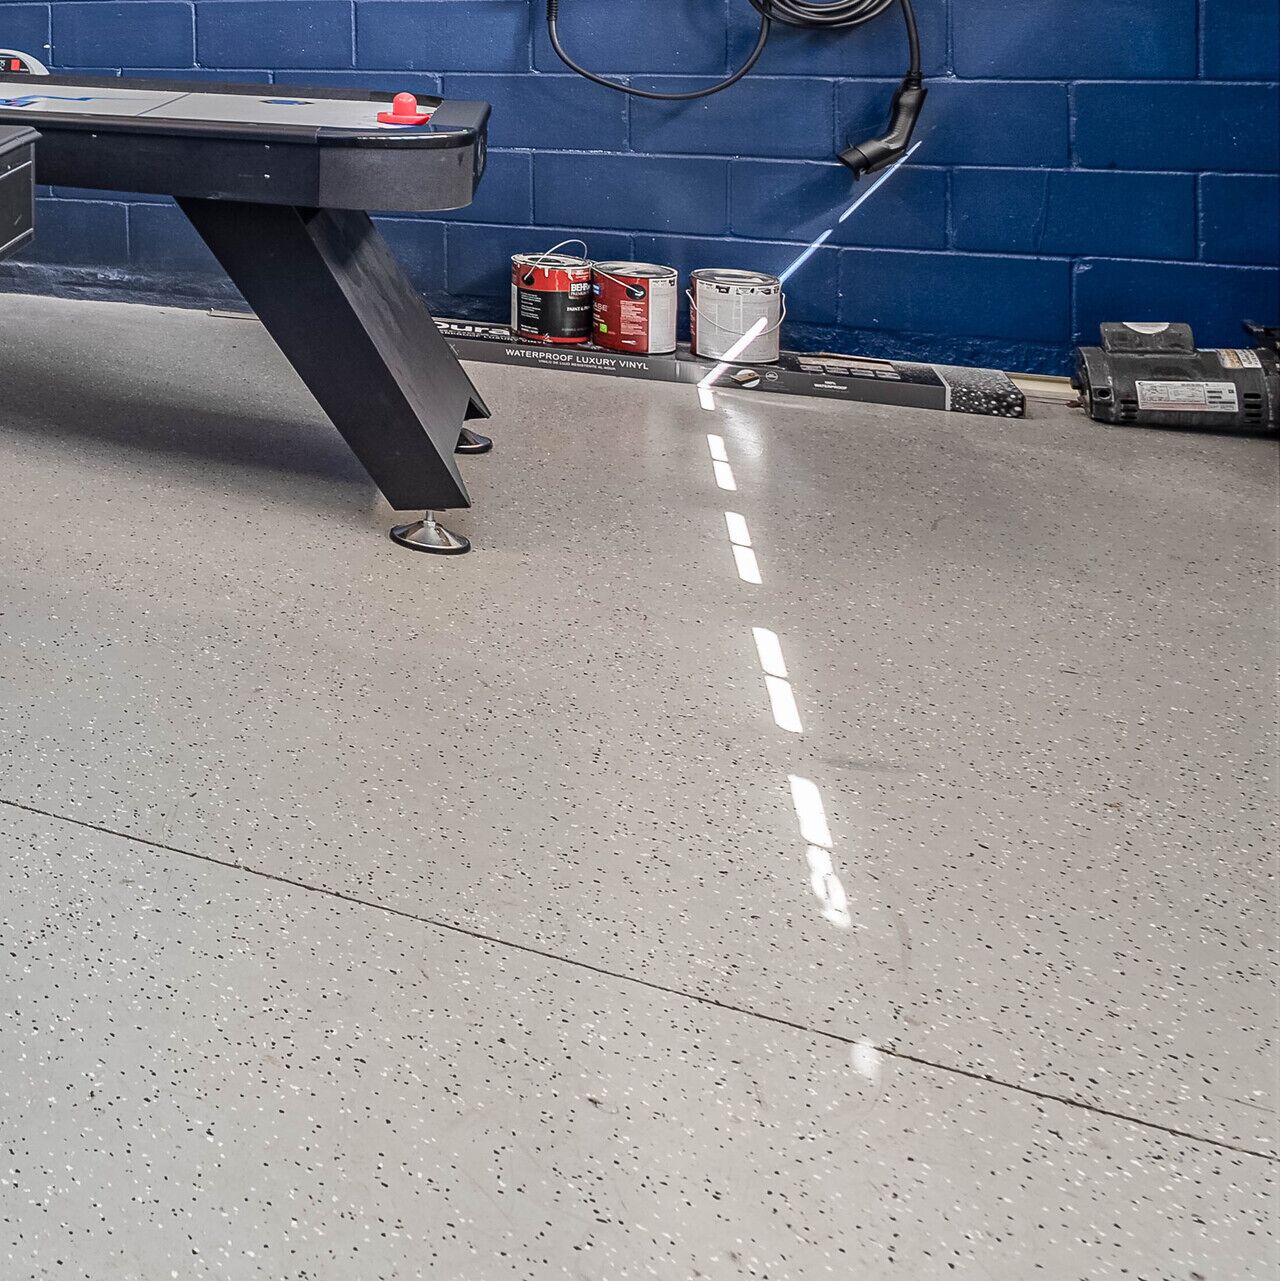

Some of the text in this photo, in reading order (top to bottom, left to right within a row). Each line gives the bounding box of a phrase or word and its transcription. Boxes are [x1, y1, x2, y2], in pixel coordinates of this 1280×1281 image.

[505, 348, 649, 371] WATERPROOF LUXURY VINYL
